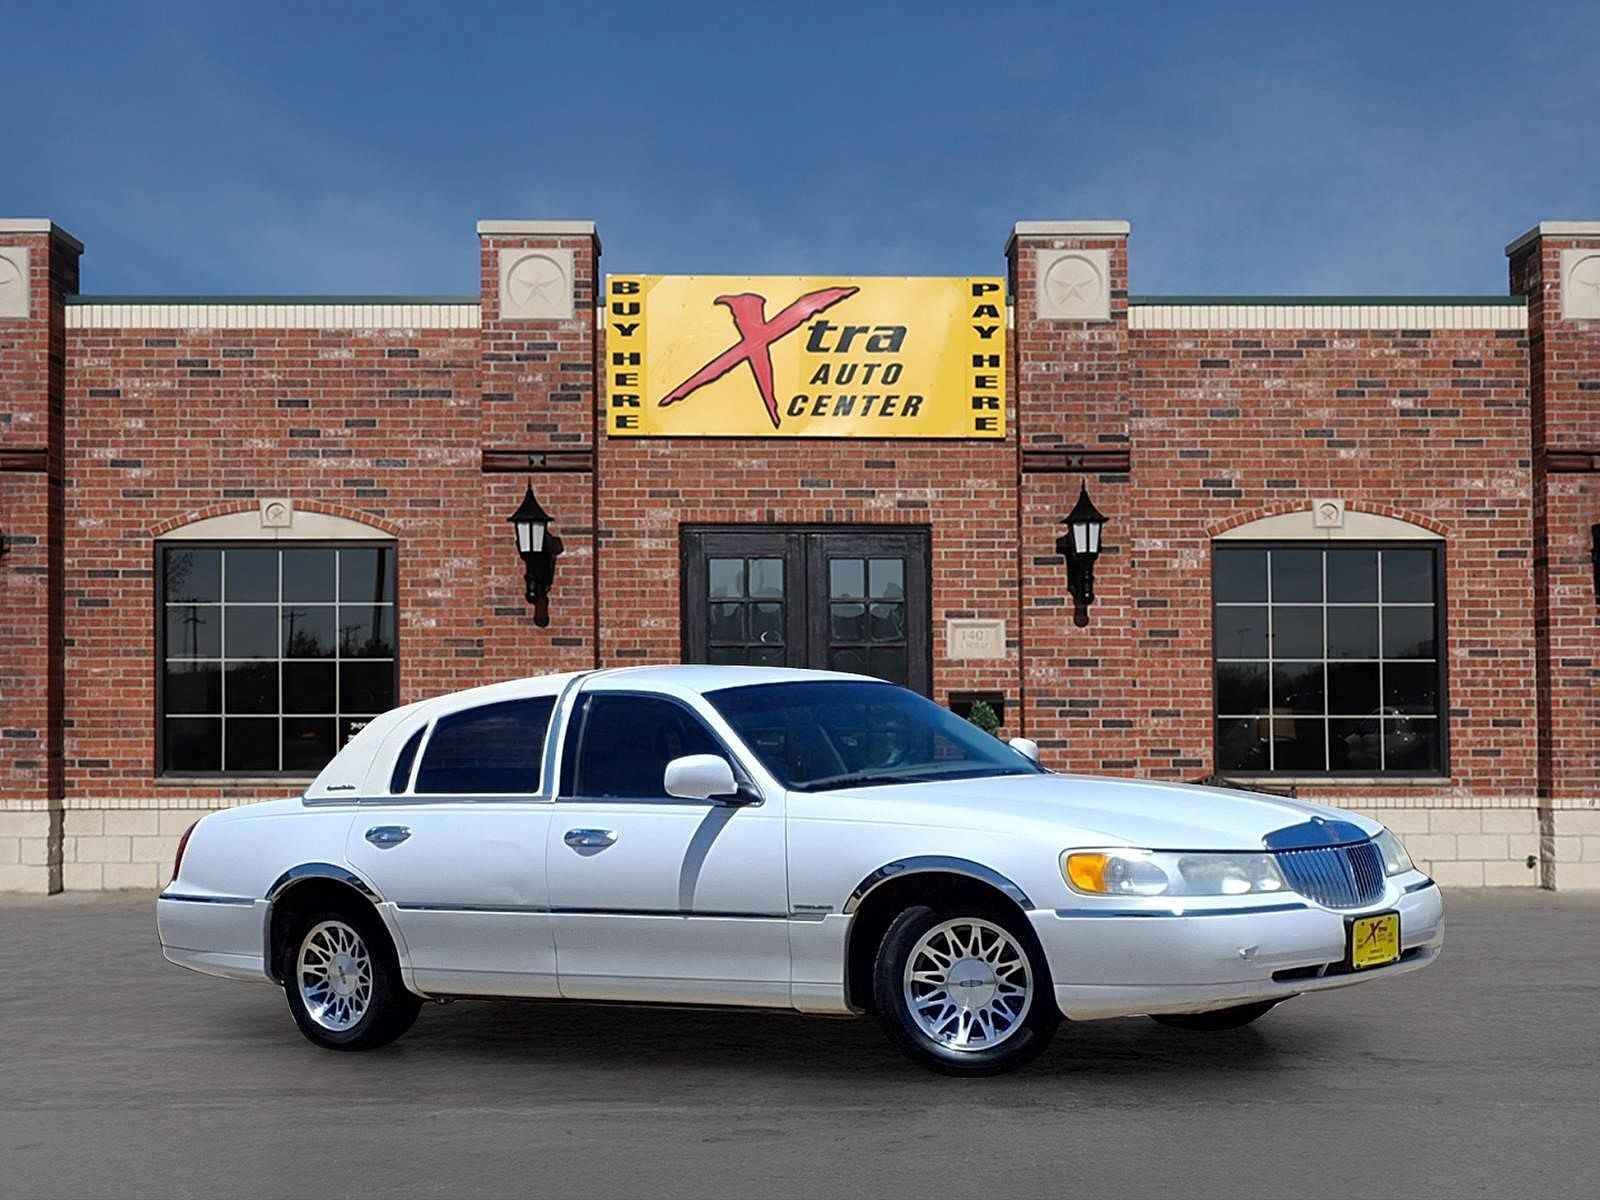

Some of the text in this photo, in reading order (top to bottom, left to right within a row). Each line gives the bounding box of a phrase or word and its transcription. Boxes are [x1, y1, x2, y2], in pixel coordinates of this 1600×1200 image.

[612, 281, 640, 429] BUY HERE
[658, 286, 908, 429] Xtra
[786, 394, 924, 418] CENTER
[809, 362, 904, 386] AUTO
[972, 283, 1000, 431] PAY HERE
